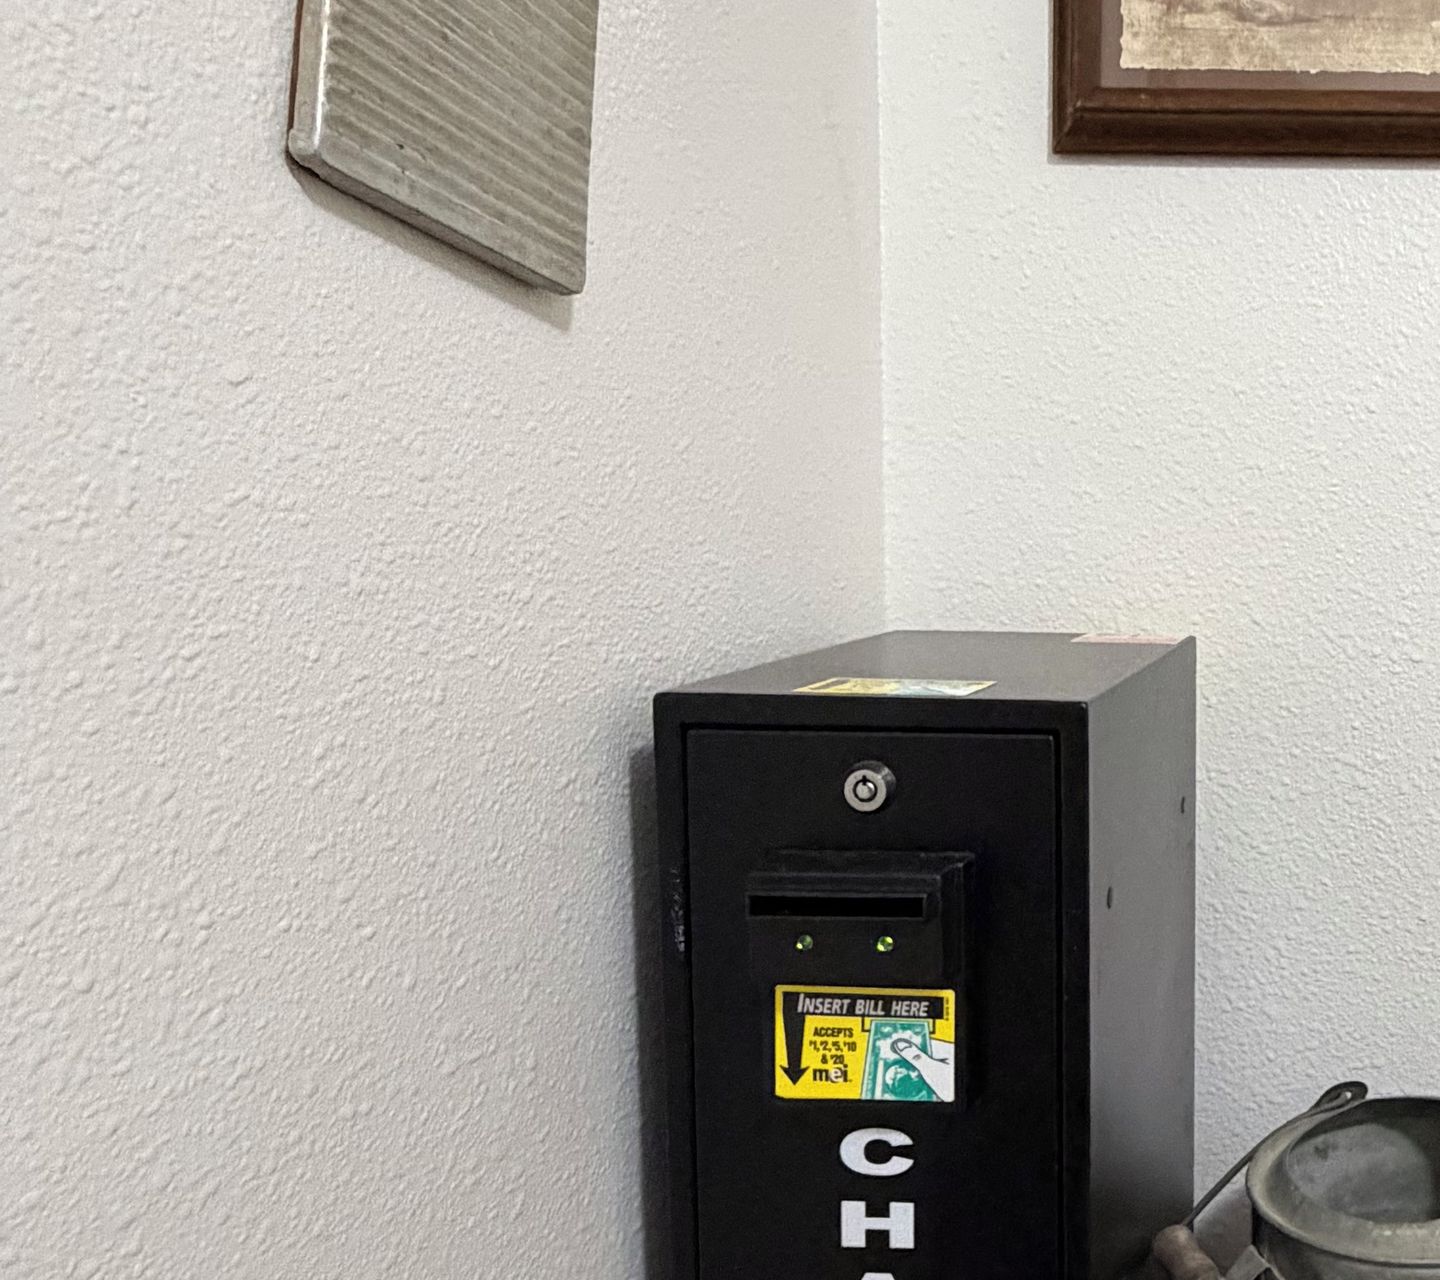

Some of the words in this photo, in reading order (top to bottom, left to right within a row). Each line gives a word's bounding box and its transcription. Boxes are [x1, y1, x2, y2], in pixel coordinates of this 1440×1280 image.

[797, 993, 851, 1014] INSERT
[855, 999, 885, 1015] BILL
[891, 1000, 929, 1017] HERE
[813, 1026, 854, 1038] ACCEPTS
[812, 1063, 848, 1083] mei
